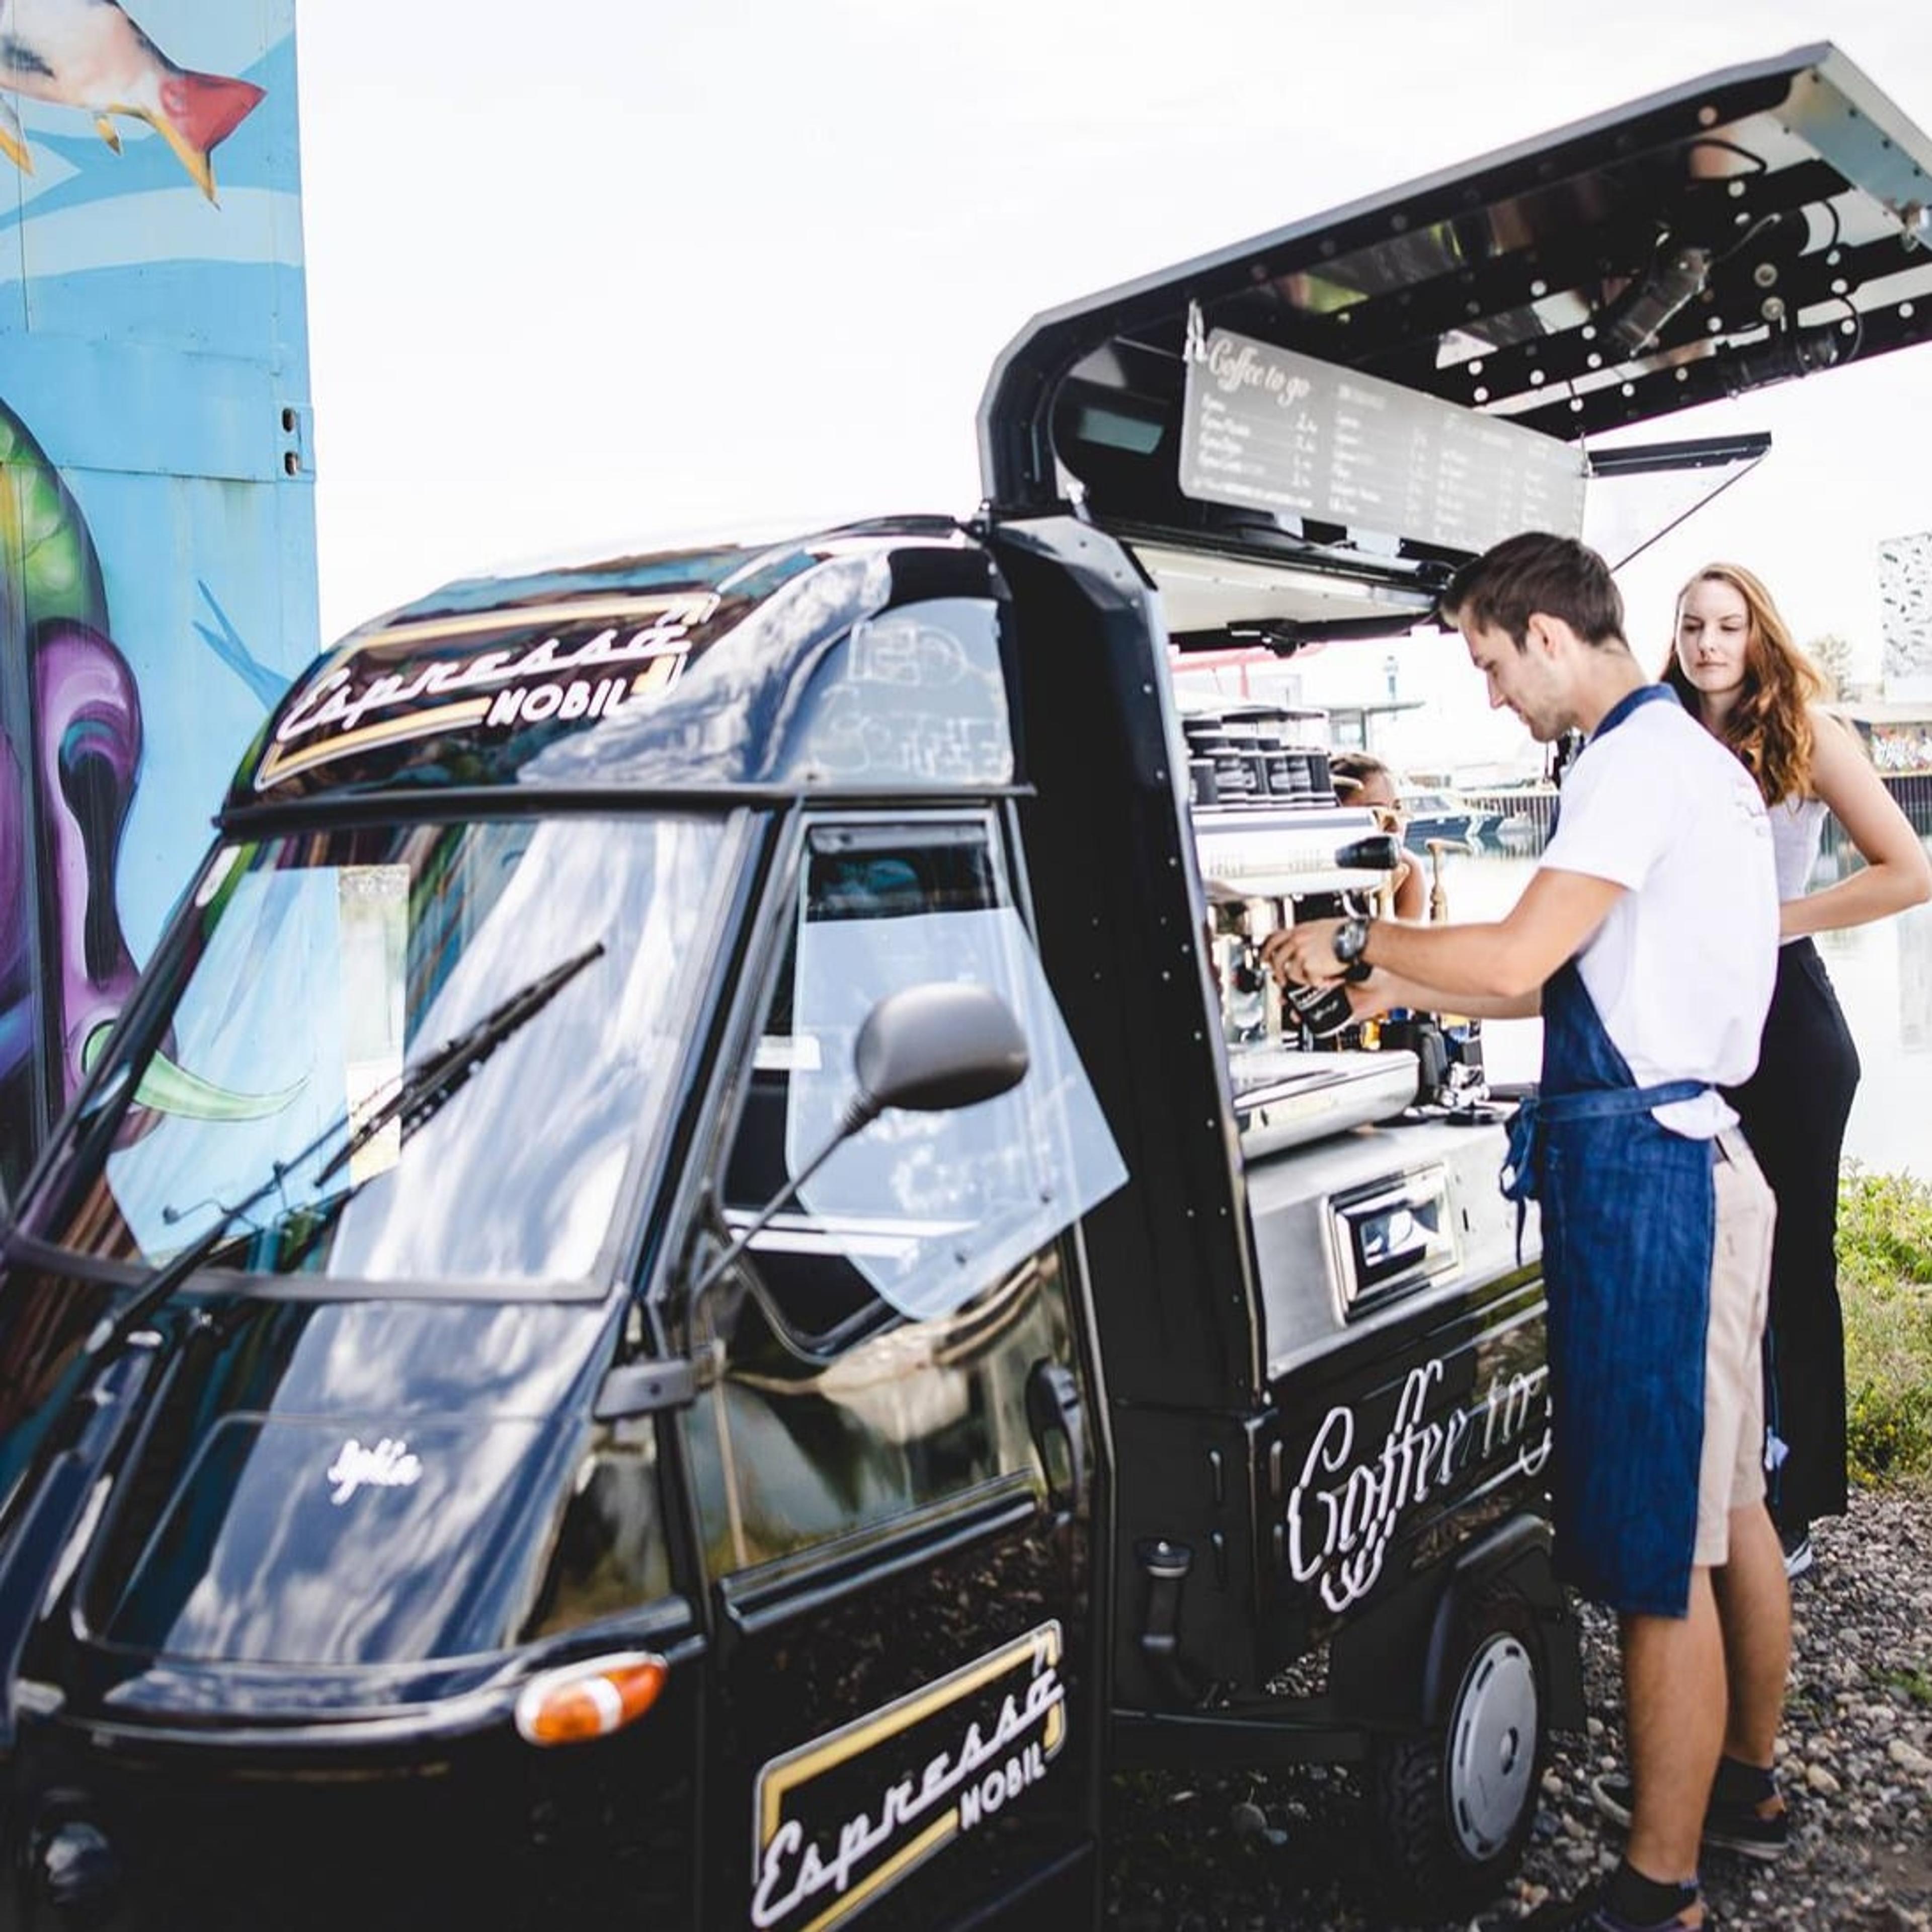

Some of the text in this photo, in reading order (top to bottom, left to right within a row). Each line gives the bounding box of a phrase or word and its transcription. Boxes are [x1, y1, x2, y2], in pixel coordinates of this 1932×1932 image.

[1210, 338, 1264, 393] Coffee
[1264, 365, 1286, 391] to
[1277, 376, 1311, 409] go
[276, 624, 693, 741] Espresso
[486, 677, 629, 727] MOBIL
[1287, 1359, 1468, 1612] Coffee
[751, 1667, 1065, 1927] Espresso
[960, 1740, 1046, 1830] MOBIL
